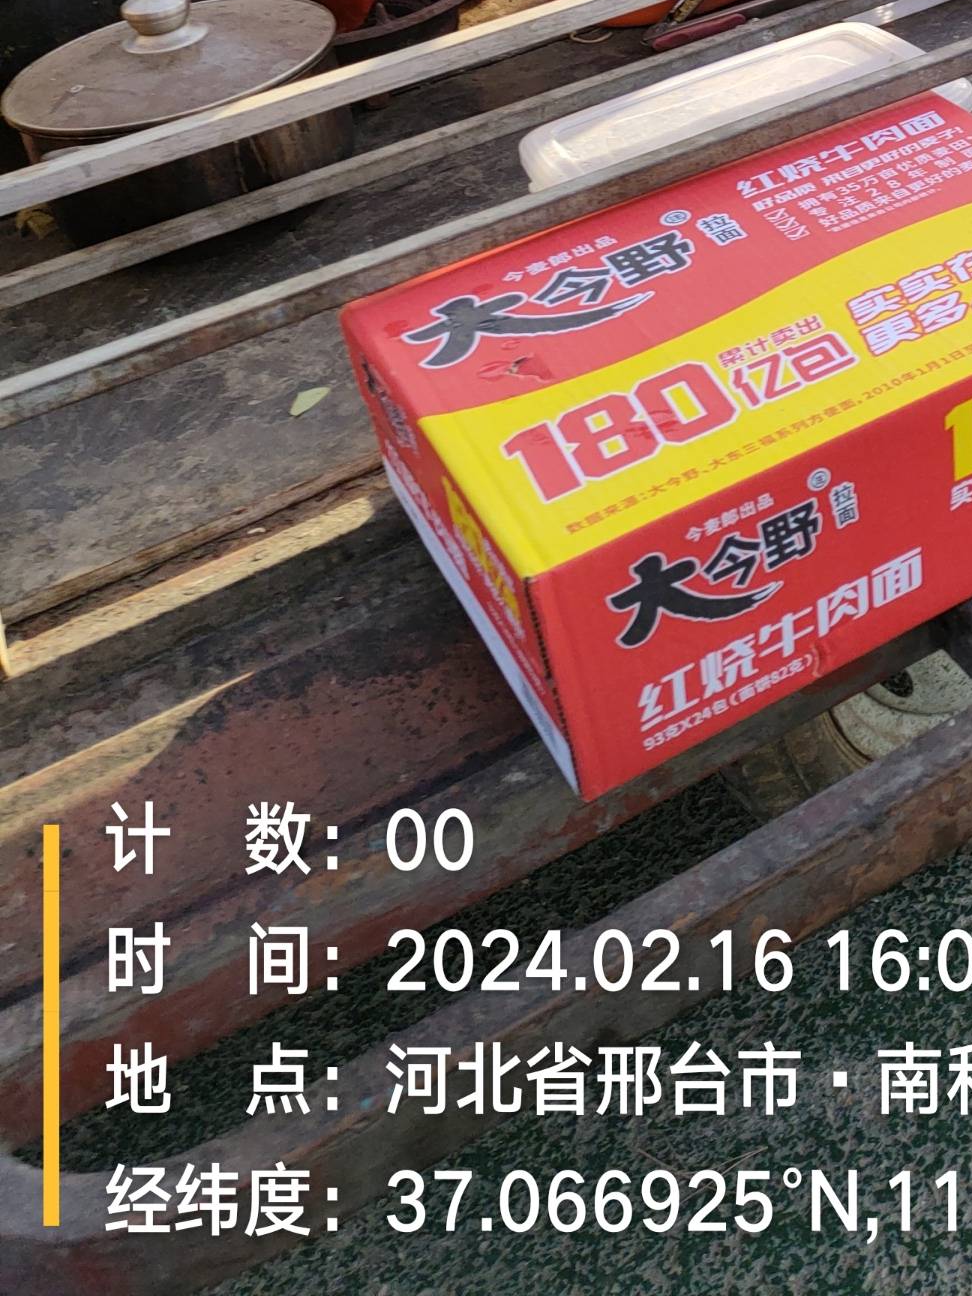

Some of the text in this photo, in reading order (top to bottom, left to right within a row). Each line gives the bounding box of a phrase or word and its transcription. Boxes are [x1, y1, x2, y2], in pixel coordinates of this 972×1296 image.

[736, 111, 946, 198] 红烧牛肉面
[752, 182, 817, 212] 好品质
[696, 213, 749, 246] 拉面
[503, 236, 618, 282] 今麦郎出品
[401, 230, 695, 370] 大今野
[717, 314, 822, 368] 累计卖出
[501, 360, 741, 502] 180
[729, 331, 861, 410] 亿包
[685, 492, 775, 543] 今麦郎出品
[828, 481, 859, 529] 拉面
[605, 497, 823, 649] 大今野
[637, 547, 923, 732] 红烧牛肉面
